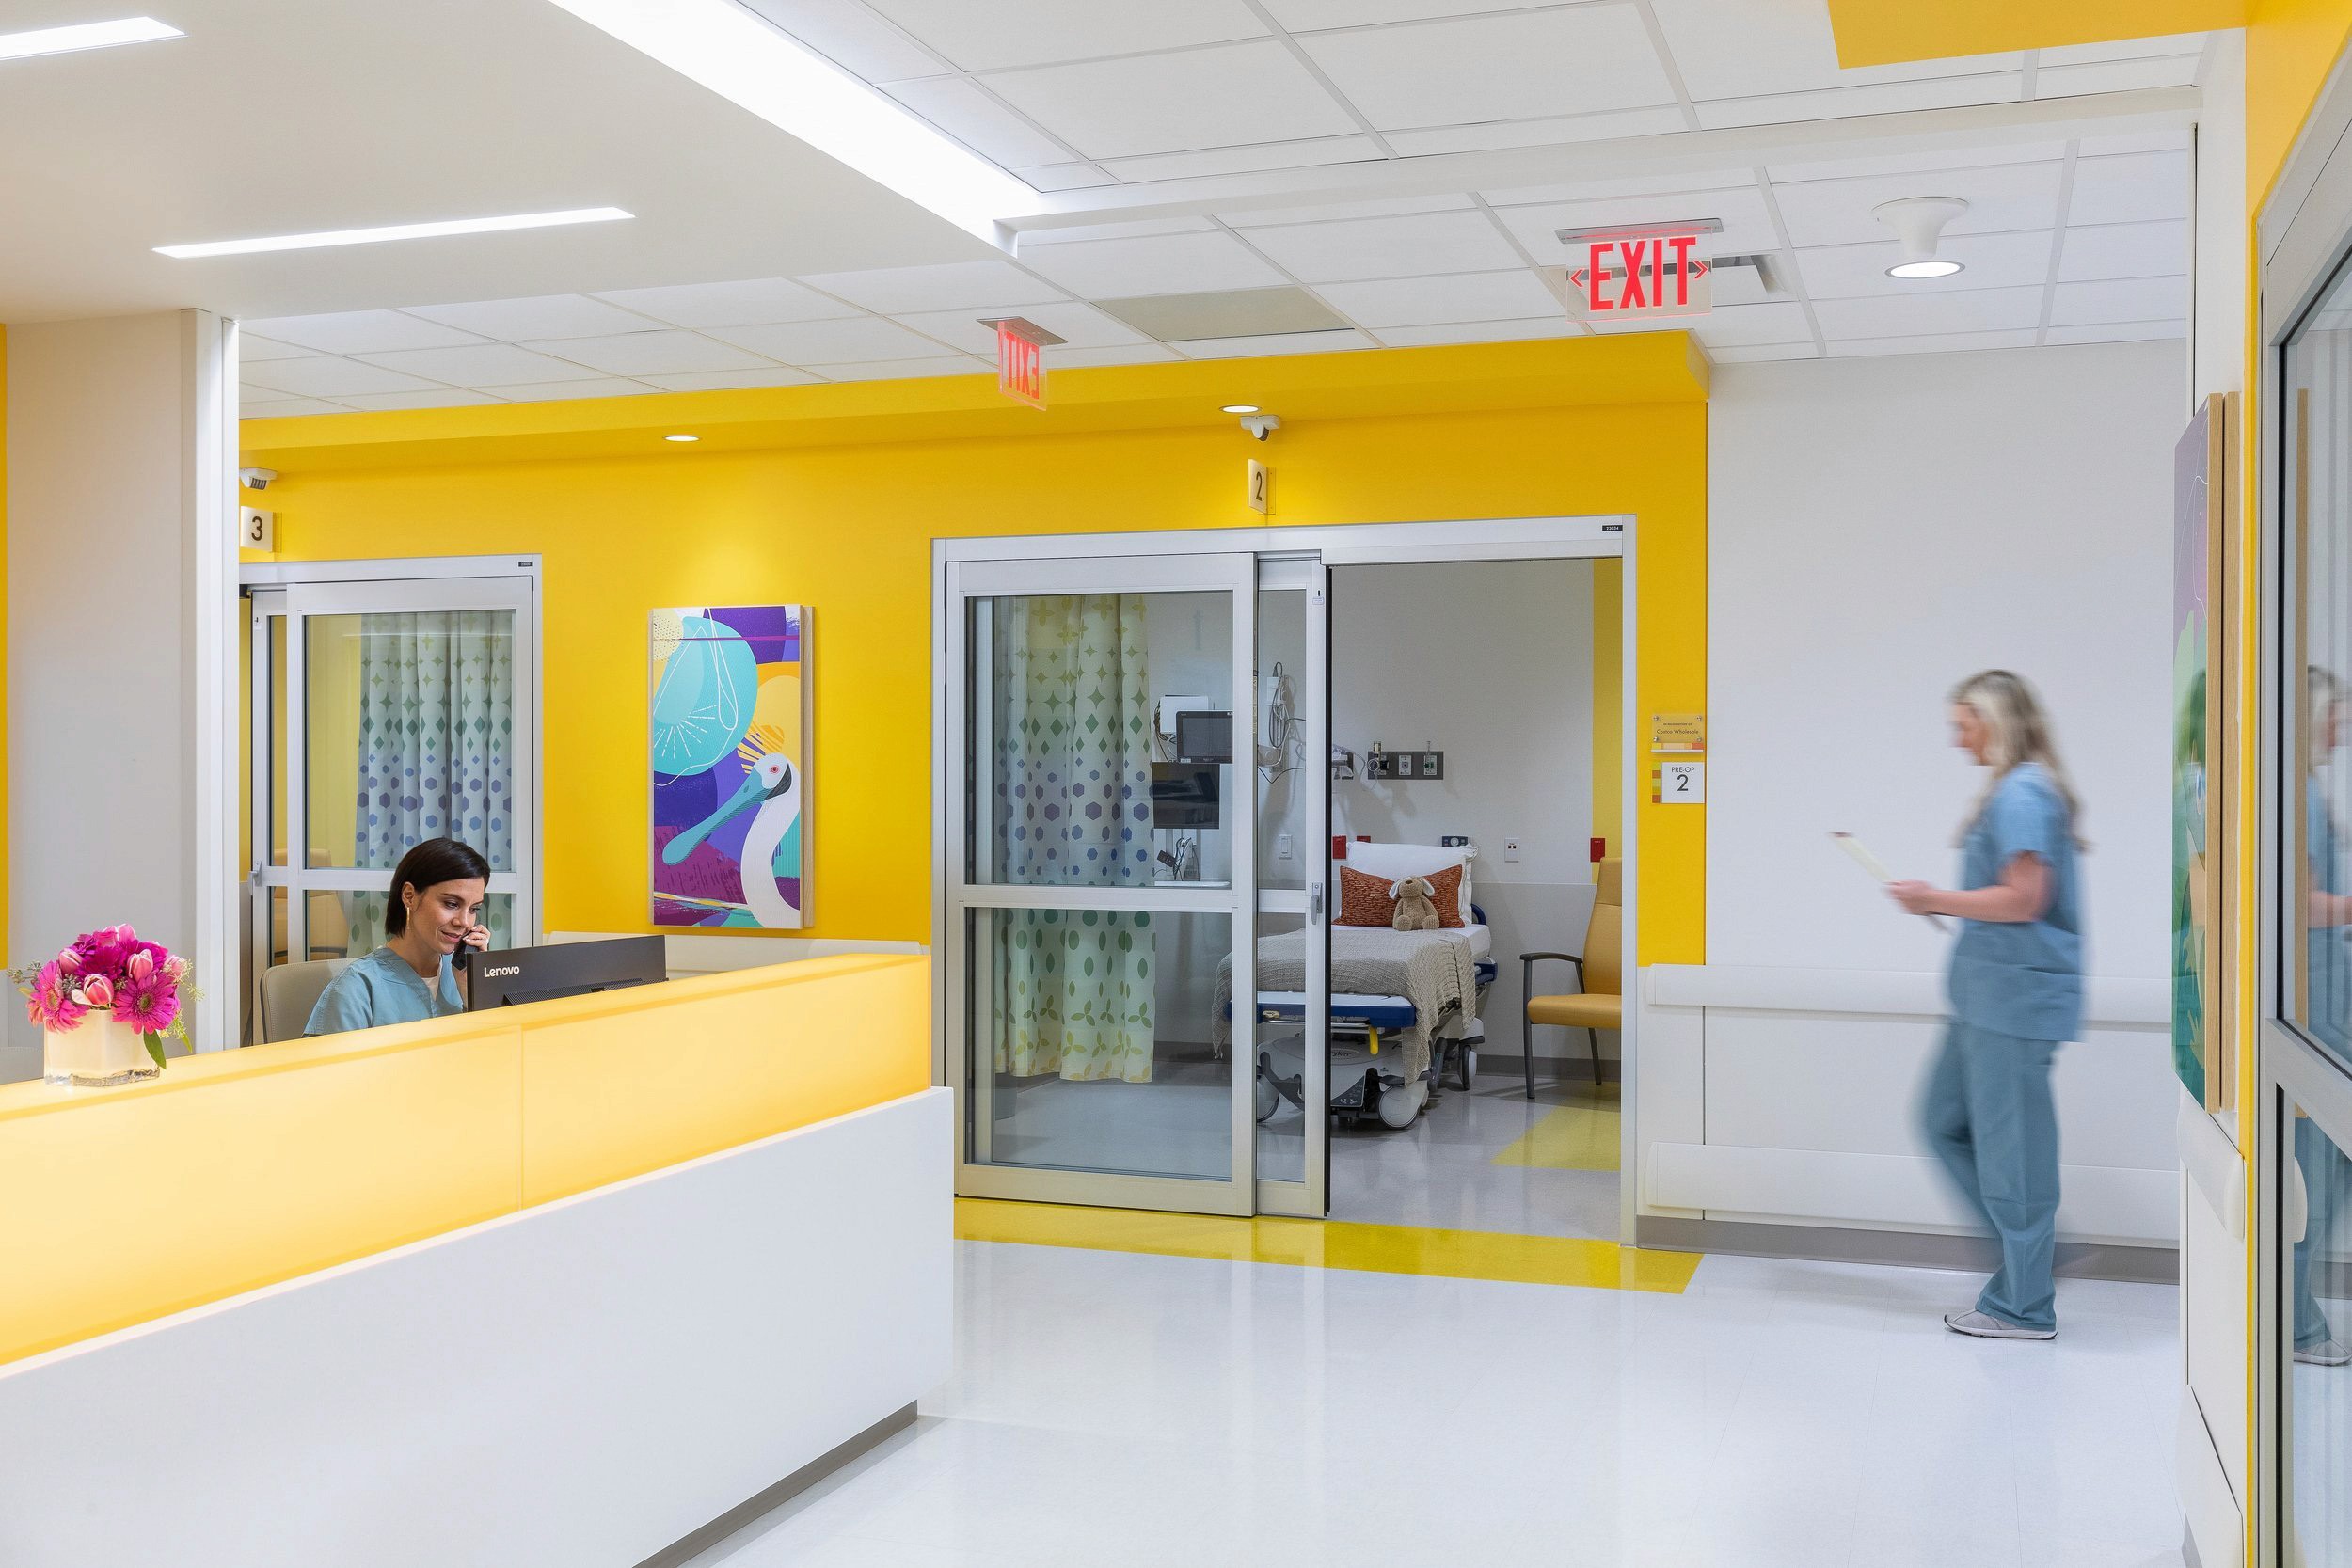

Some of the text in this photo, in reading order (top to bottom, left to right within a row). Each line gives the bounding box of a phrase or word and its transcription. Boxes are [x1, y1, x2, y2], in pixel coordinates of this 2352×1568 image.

[1589, 235, 1697, 312] EXIT
[1255, 471, 1263, 502] 2
[251, 515, 263, 542] 3
[1677, 773, 1689, 792] 2
[484, 966, 520, 978] Lenovo
